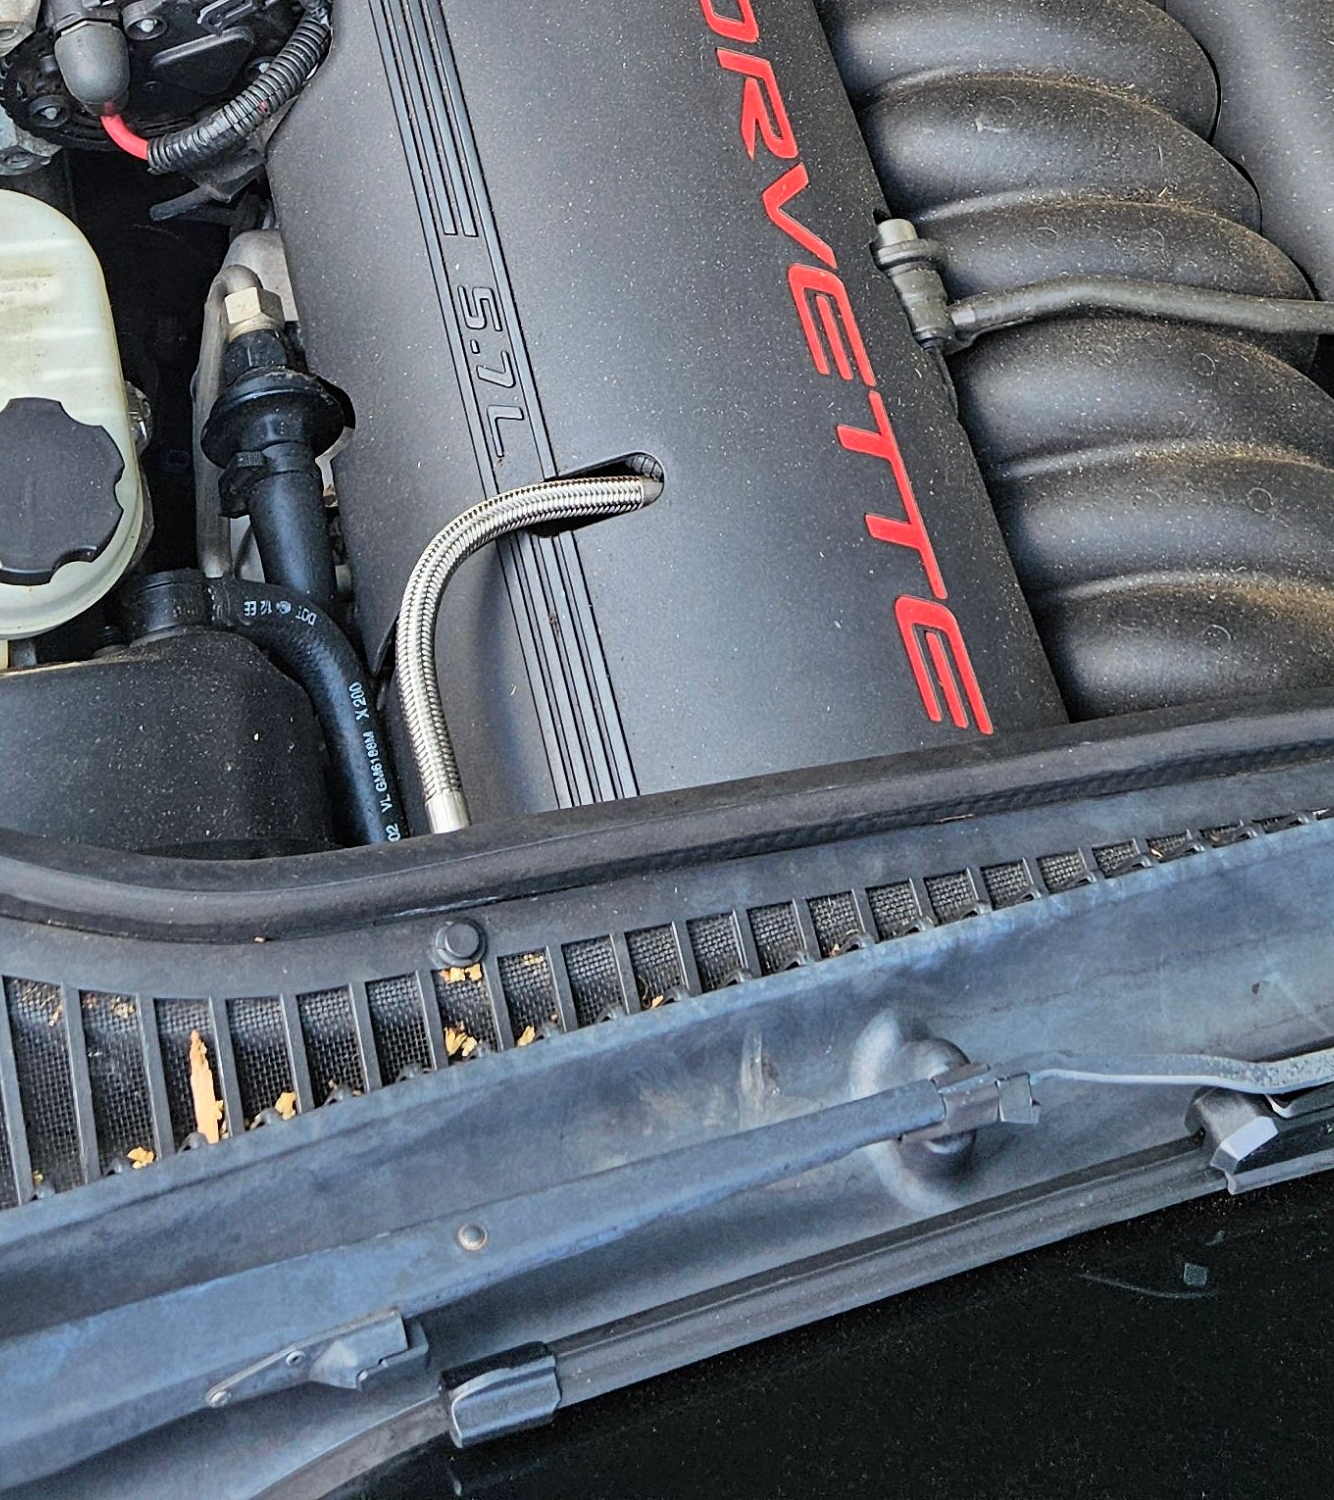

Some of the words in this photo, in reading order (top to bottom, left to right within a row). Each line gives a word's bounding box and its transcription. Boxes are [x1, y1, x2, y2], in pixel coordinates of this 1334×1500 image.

[455, 285, 527, 460] 5.7L
[294, 605, 317, 626] DOT
[380, 793, 392, 812] VL
[385, 822, 400, 841] 02
